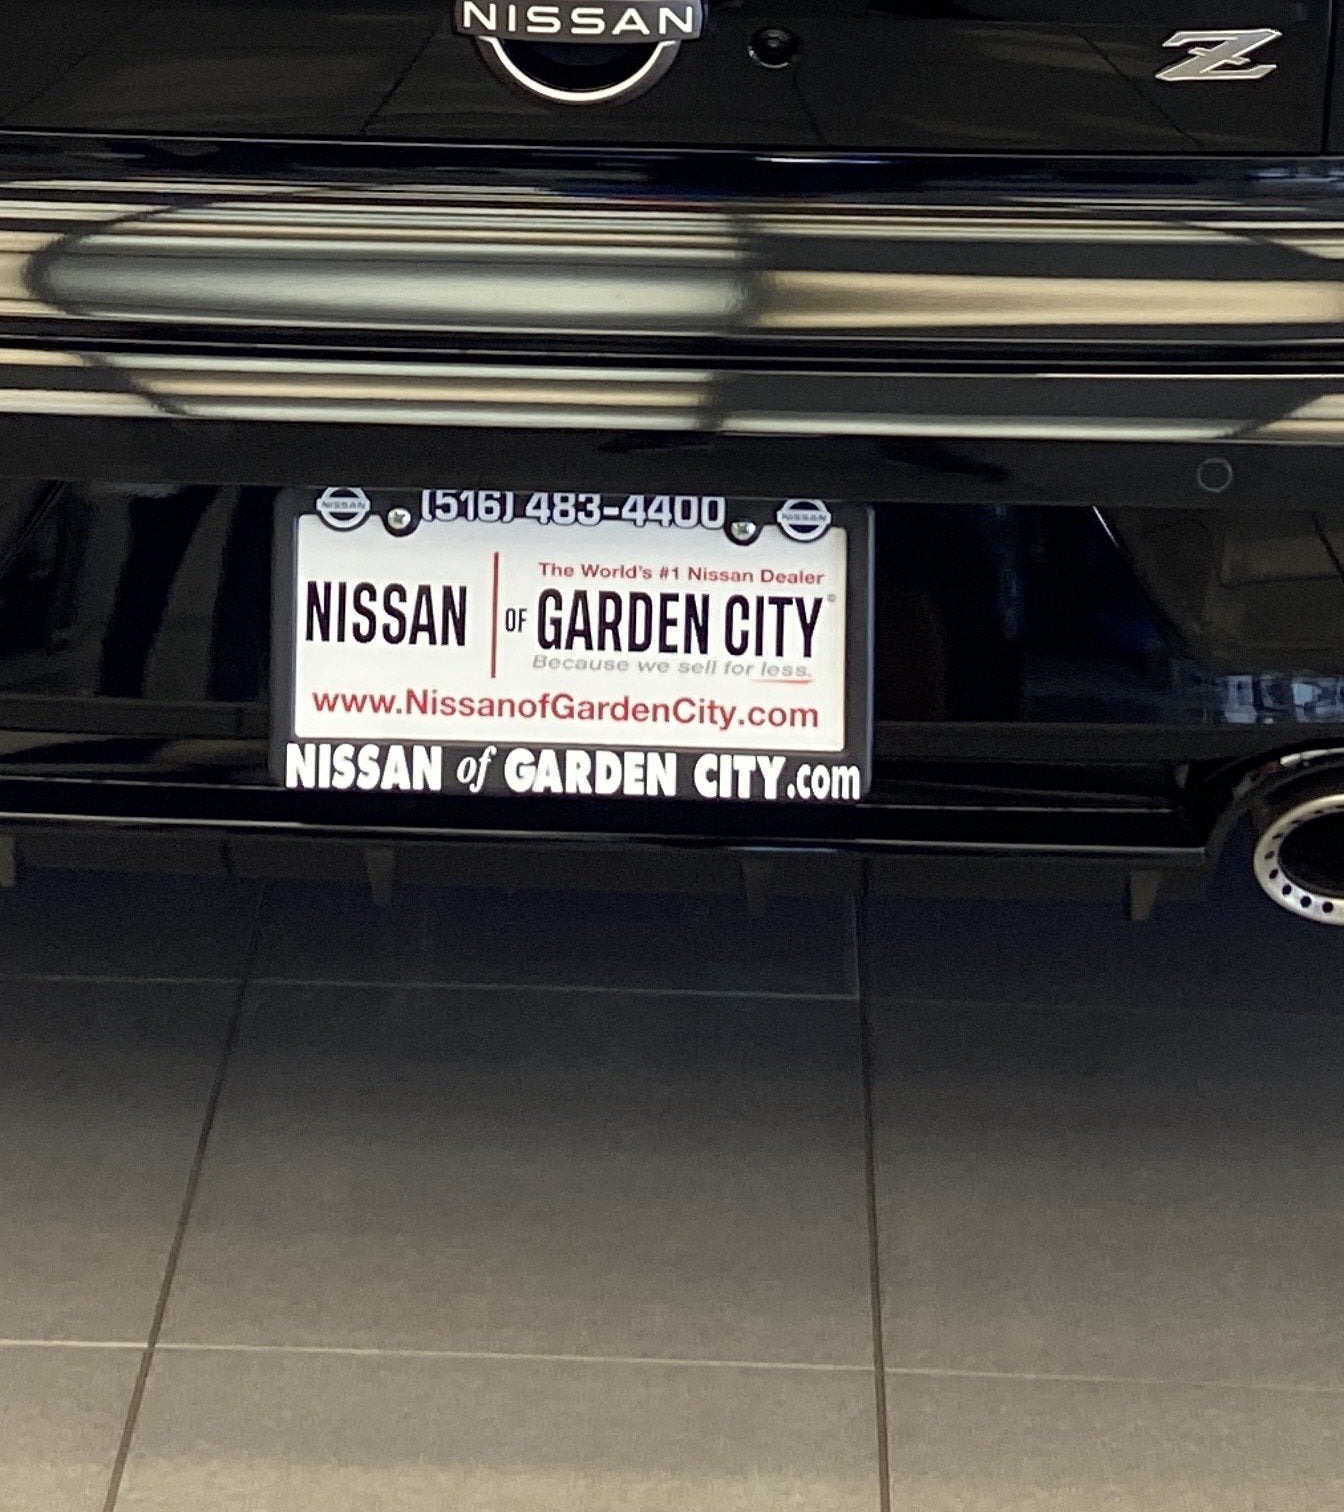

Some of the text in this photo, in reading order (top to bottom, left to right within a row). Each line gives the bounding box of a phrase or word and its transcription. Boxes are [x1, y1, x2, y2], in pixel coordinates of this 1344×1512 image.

[462, 0, 694, 36] NISSAN
[1155, 27, 1284, 82] Z
[320, 499, 367, 511] NISSAN
[421, 489, 727, 529] (516) 483-4400
[780, 512, 828, 523] NISSAN
[538, 561, 825, 585] The World's #1 Nissan Dealer
[305, 581, 468, 647] NISSAN
[505, 588, 824, 659] OF GARDEN CITY
[532, 654, 812, 679] Because we sell for less.
[312, 688, 820, 732] www.NissanofGardenCity.com
[285, 742, 861, 801] NISSAN of GARDEN CITY.com
